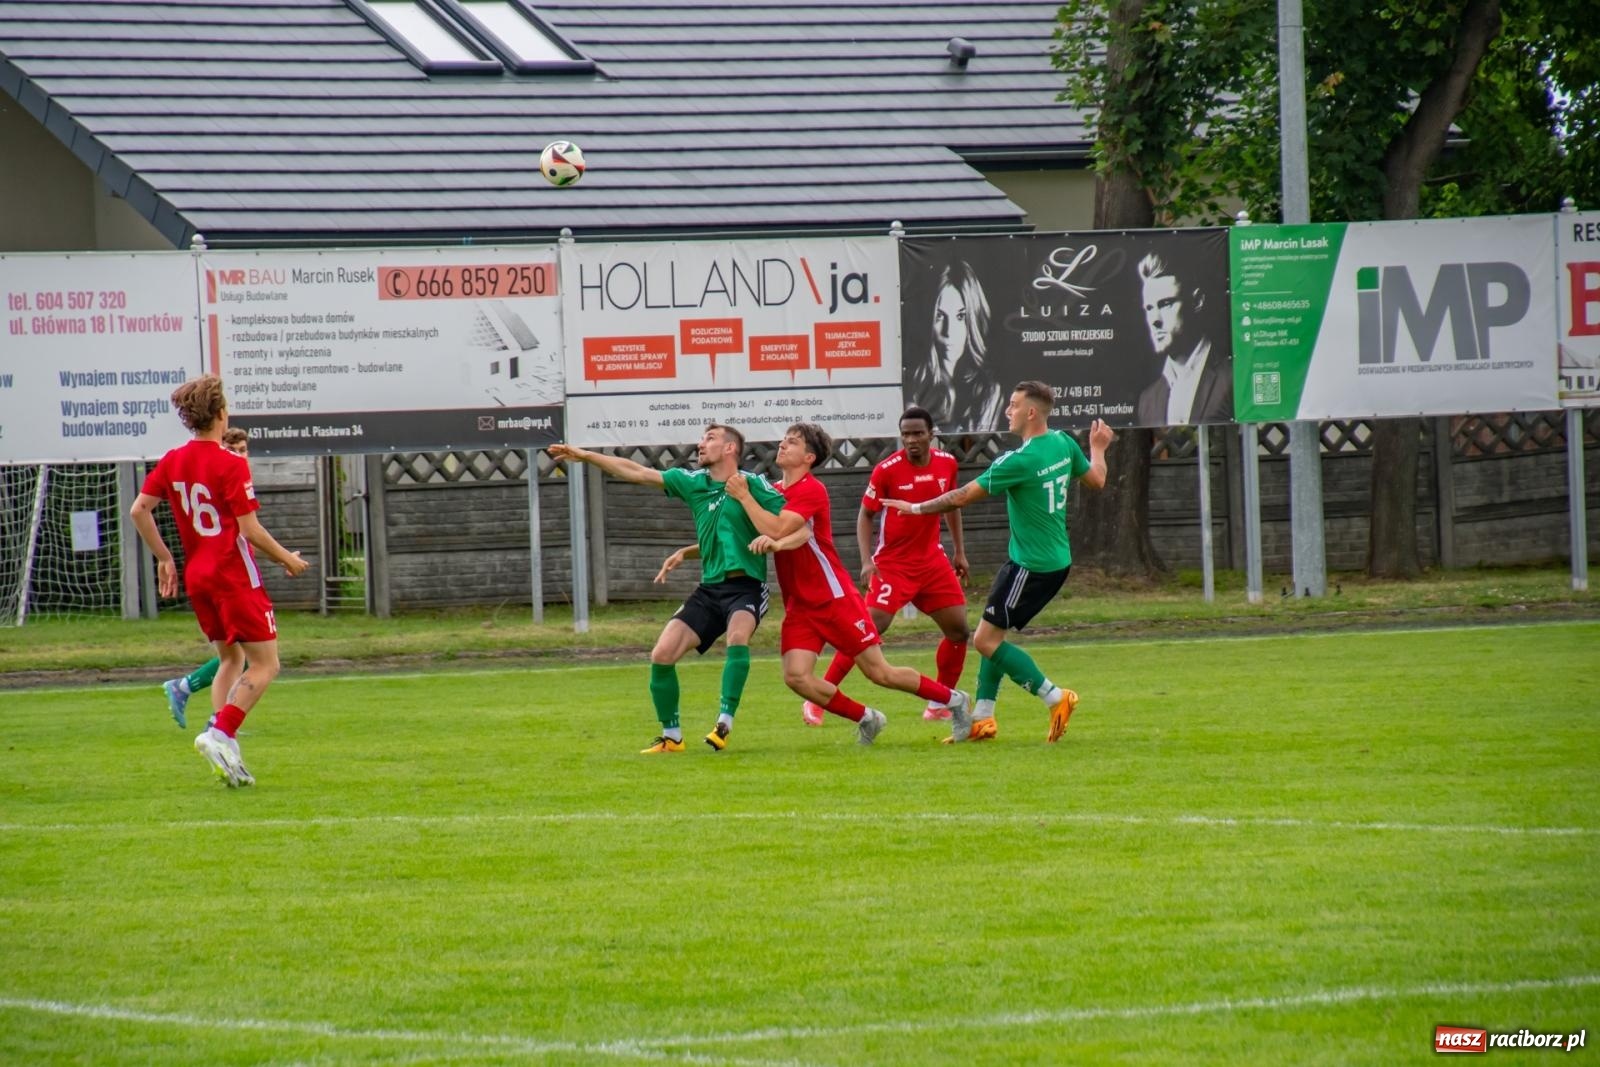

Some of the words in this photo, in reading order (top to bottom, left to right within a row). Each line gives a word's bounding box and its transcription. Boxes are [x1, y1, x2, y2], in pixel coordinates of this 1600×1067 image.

[1240, 239, 1261, 251] iMP
[1263, 237, 1298, 249] Marcin
[1301, 236, 1329, 248] Lasak
[292, 268, 334, 284] Marcin
[337, 267, 375, 283] Rusek
[416, 268, 453, 297] 666
[461, 267, 499, 296] 859
[507, 266, 545, 295] 250
[580, 258, 794, 311] HOLLAND
[8, 292, 32, 311] tel.
[36, 292, 63, 310] 604
[68, 291, 94, 309] 507
[99, 291, 126, 309] 320
[246, 291, 288, 301] Budowlane
[1020, 304, 1113, 318] LUIZA
[1357, 261, 1531, 364] iMP
[9, 317, 28, 335] ul.
[32, 315, 86, 335] Główna
[90, 316, 105, 333] 18
[118, 313, 183, 333] Tworków
[231, 314, 289, 327] kompleksowa
[291, 312, 323, 325] budowa
[325, 310, 355, 324] domów
[232, 331, 278, 343] rozbudowa
[286, 330, 336, 344] przebudowa
[338, 327, 380, 342] budynków
[382, 327, 439, 342] mieszkalnych
[690, 327, 733, 336] ROZLICZENIA
[1022, 331, 1046, 342] STUDIO
[1047, 330, 1070, 341] SZTUKI
[1071, 329, 1114, 340] FRYZJERSKIEJ
[691, 336, 733, 344] PODATKOWE
[233, 348, 267, 361] remonty
[278, 347, 332, 360] wykończenia
[611, 344, 646, 352] WSZYSTKIE
[760, 344, 798, 352] EMERYTURY
[591, 353, 639, 362] HOLENDERSKIE
[640, 353, 668, 361] SPRAWY
[760, 353, 765, 361] Z
[233, 367, 252, 377] oraz
[255, 366, 272, 376] inne
[275, 364, 300, 377] usługi
[302, 364, 349, 375] remontowo
[358, 362, 403, 374] budowlane
[605, 363, 632, 371] JEDNYM
[634, 362, 663, 370] MIEJSCU
[59, 369, 117, 389] Wynajem
[121, 367, 186, 386] rusztowań
[234, 381, 269, 394] projekty
[271, 380, 317, 392] budowlane
[1069, 386, 1082, 398] 419
[1083, 386, 1092, 397] 61
[1093, 385, 1102, 397] 21
[61, 399, 119, 418] Wynajem
[122, 398, 169, 419] sprzętu
[235, 397, 263, 410] nadzór
[266, 396, 312, 410] budowlany
[649, 402, 691, 411] dutchables
[739, 400, 755, 409] 36/1
[764, 399, 789, 408] 47-400
[791, 397, 823, 407] Racibórz
[1061, 405, 1072, 416] 16,
[1073, 404, 1098, 415] 47-451
[1099, 402, 1134, 415] Tworków
[62, 420, 147, 437] budowlanego
[498, 416, 552, 430] mrbau@wp.pl
[587, 421, 600, 430] +48
[602, 421, 611, 429] 32
[613, 420, 627, 429] 740
[628, 420, 637, 428] 91
[640, 420, 649, 428] 93
[657, 419, 670, 427] +48
[688, 418, 700, 426] 003
[263, 426, 299, 438] Tworków
[312, 425, 350, 437] Piaskowa
[351, 424, 363, 436] 34
[1042, 473, 1069, 514] 13
[172, 481, 222, 537] 16
[876, 583, 892, 606] 2
